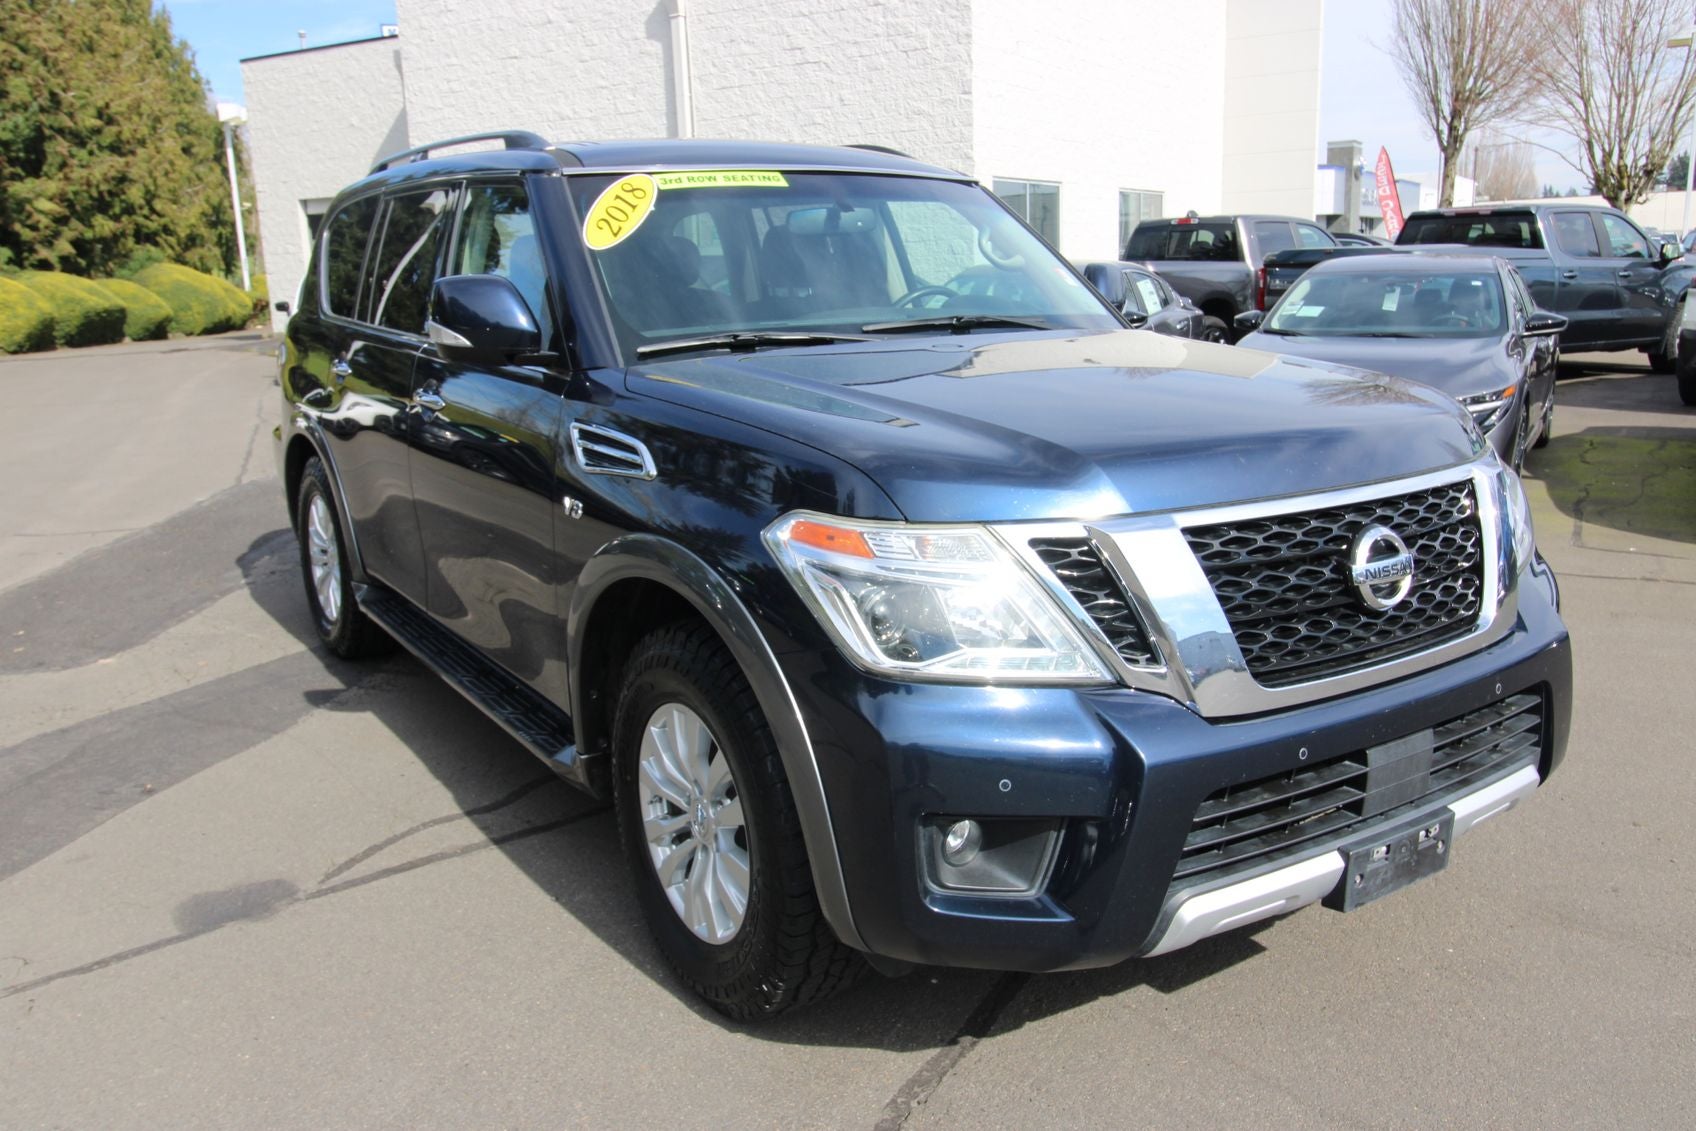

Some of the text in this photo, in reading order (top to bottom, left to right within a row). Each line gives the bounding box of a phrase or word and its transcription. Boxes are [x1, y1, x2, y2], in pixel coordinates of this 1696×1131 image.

[659, 174, 781, 186] 3rd ROW SEATING
[596, 182, 647, 238] 2018
[1364, 555, 1412, 580] NISSAN
